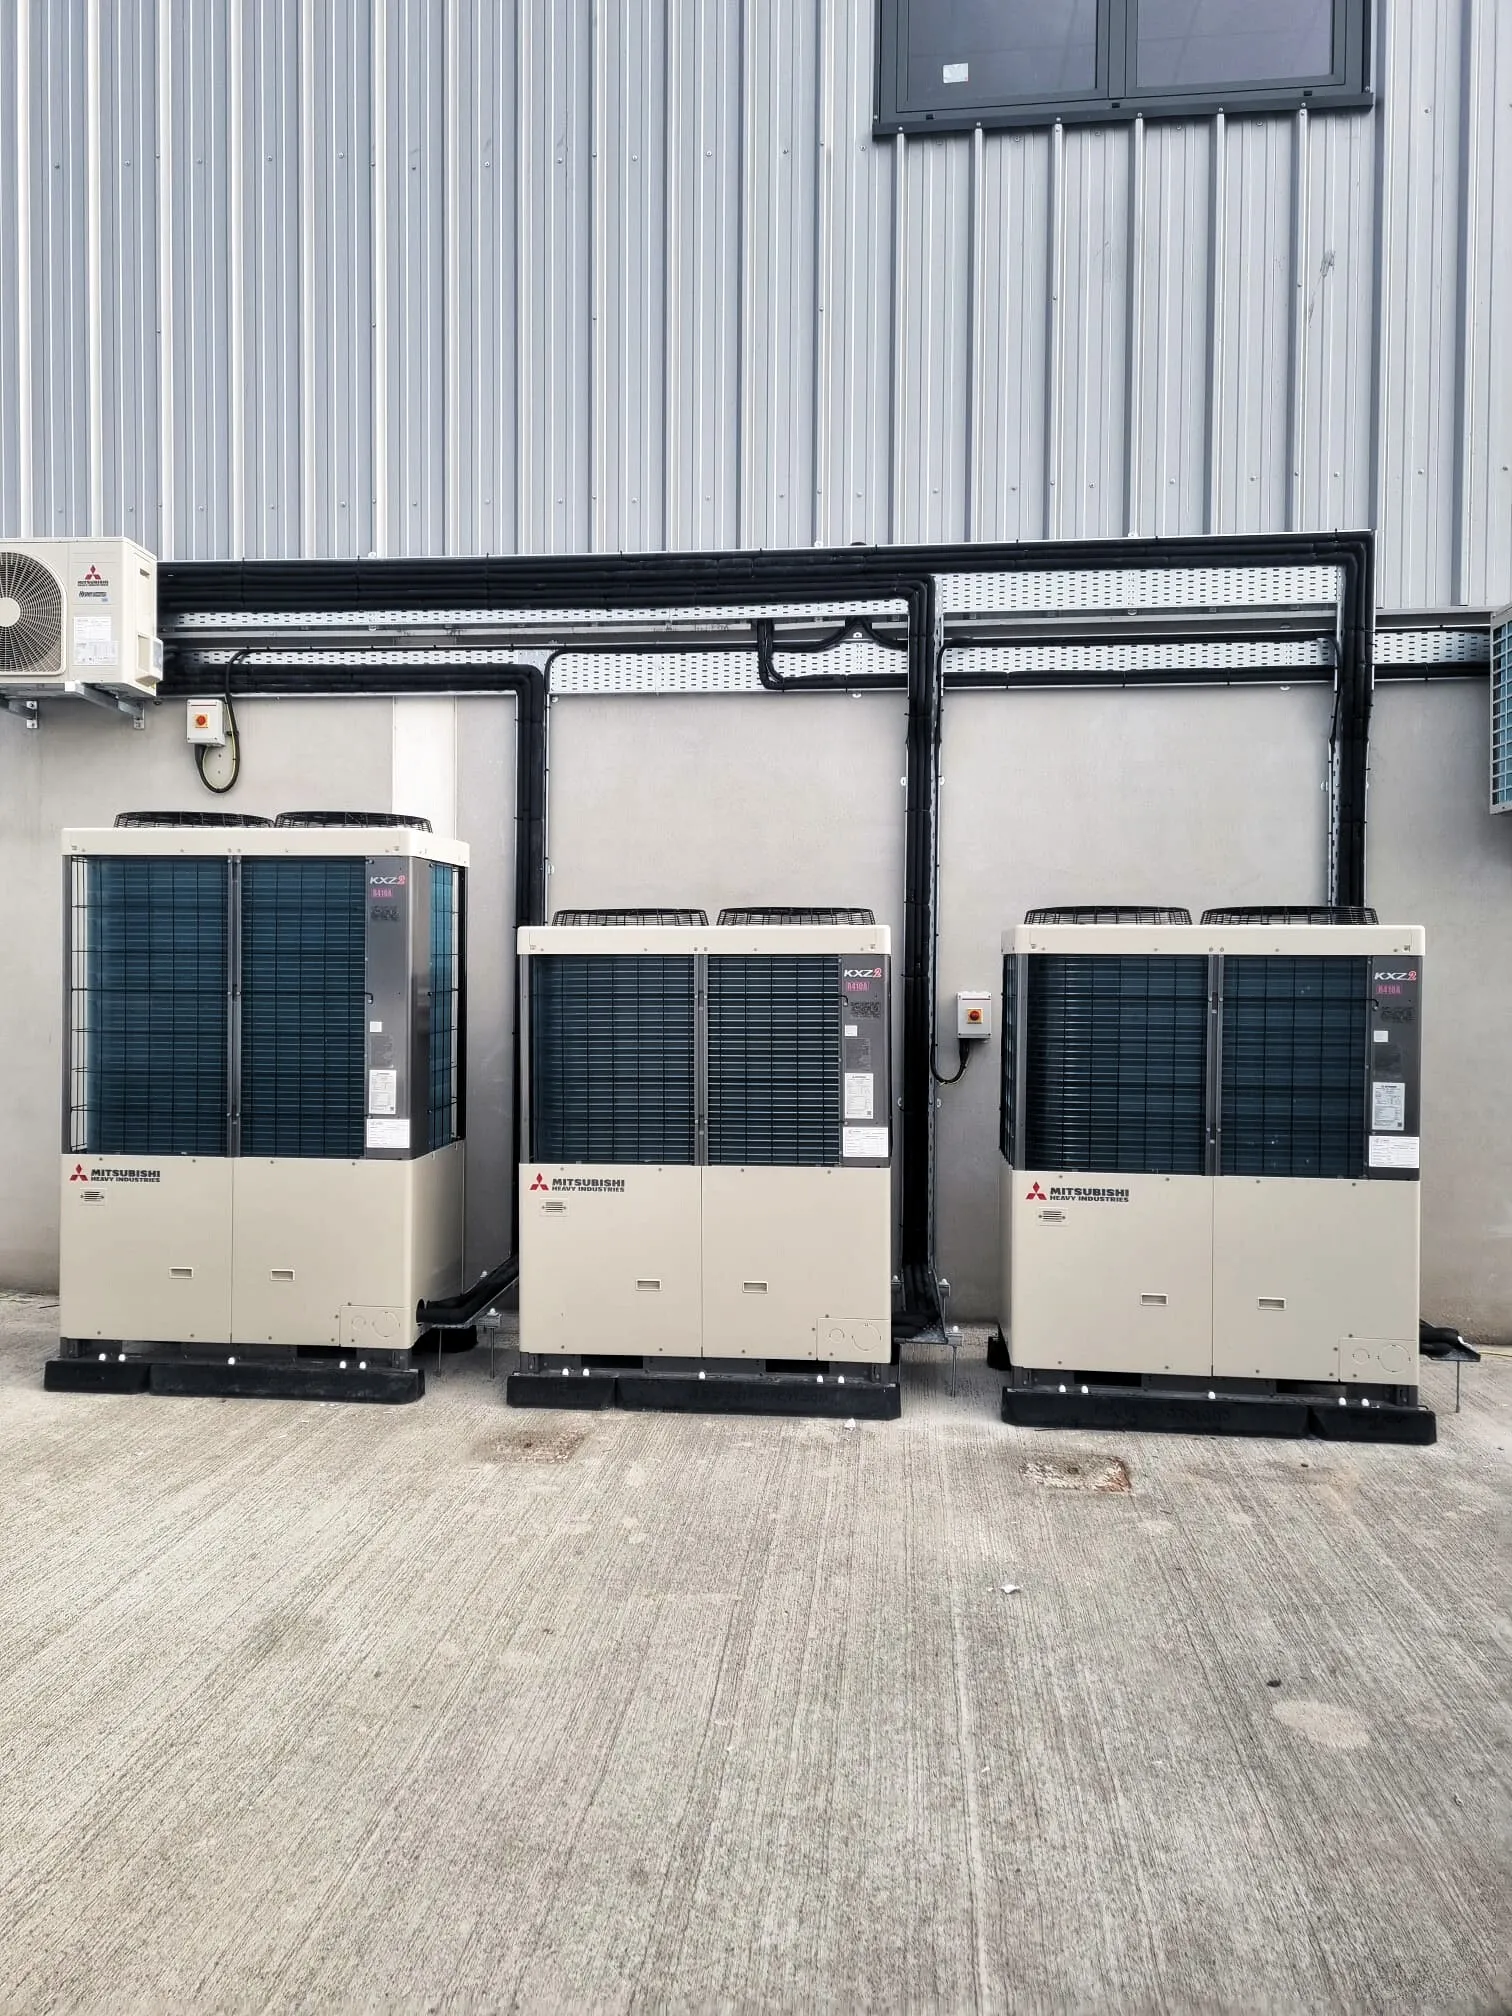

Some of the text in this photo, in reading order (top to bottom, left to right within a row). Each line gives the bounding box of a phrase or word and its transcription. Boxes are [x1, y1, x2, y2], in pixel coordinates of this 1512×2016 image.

[91, 1169, 161, 1178] MITSUBISHI
[552, 1178, 625, 1187] MITSUBISHI
[1050, 1187, 1130, 1197] MITSUBISHI
